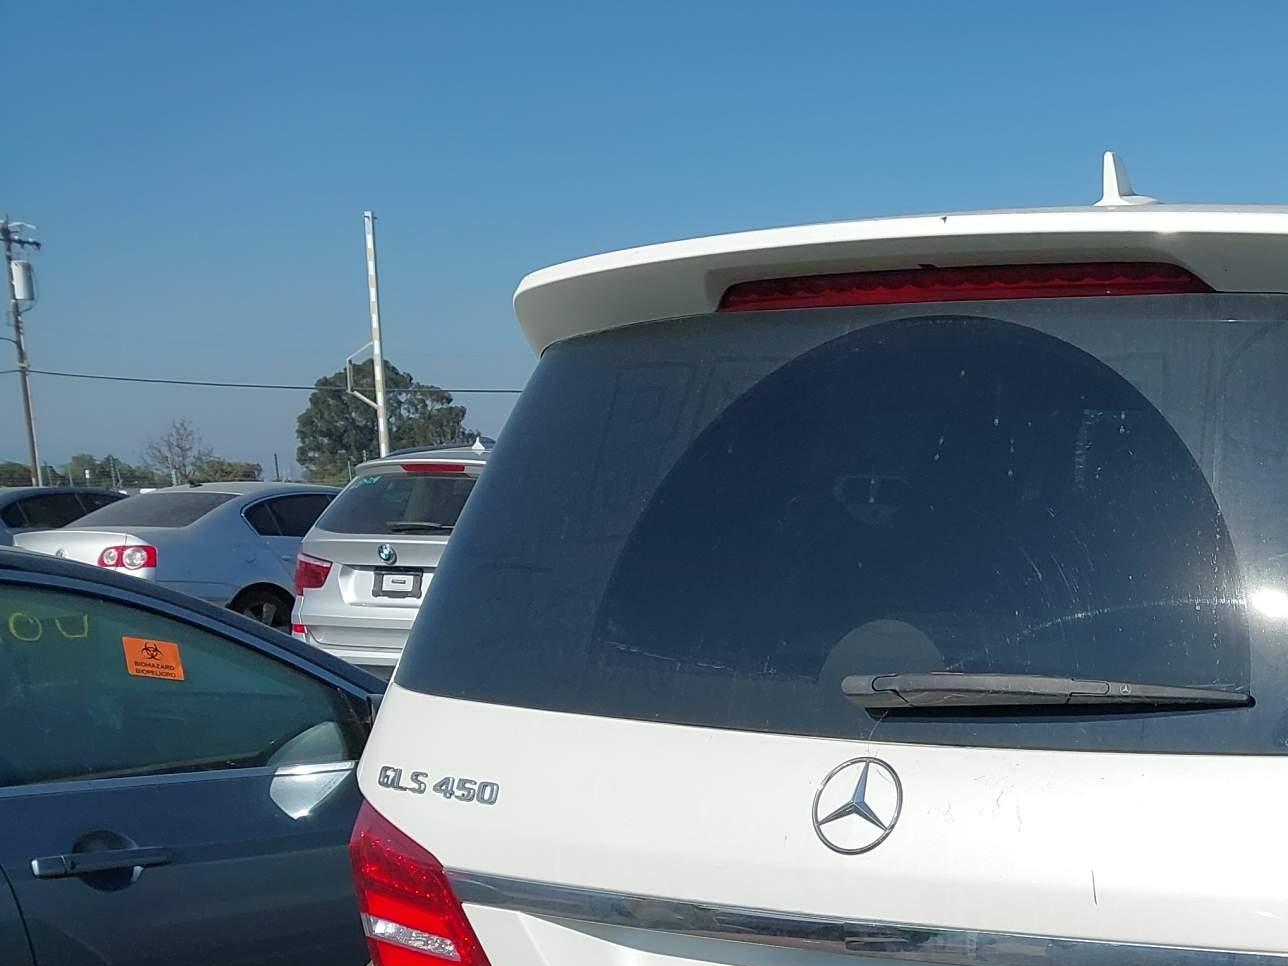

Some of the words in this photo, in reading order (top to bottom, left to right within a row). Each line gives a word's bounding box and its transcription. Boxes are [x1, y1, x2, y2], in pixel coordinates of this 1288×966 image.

[134, 660, 175, 671] BIOHAZARD
[378, 765, 429, 795] GLS
[432, 776, 500, 805] 450
